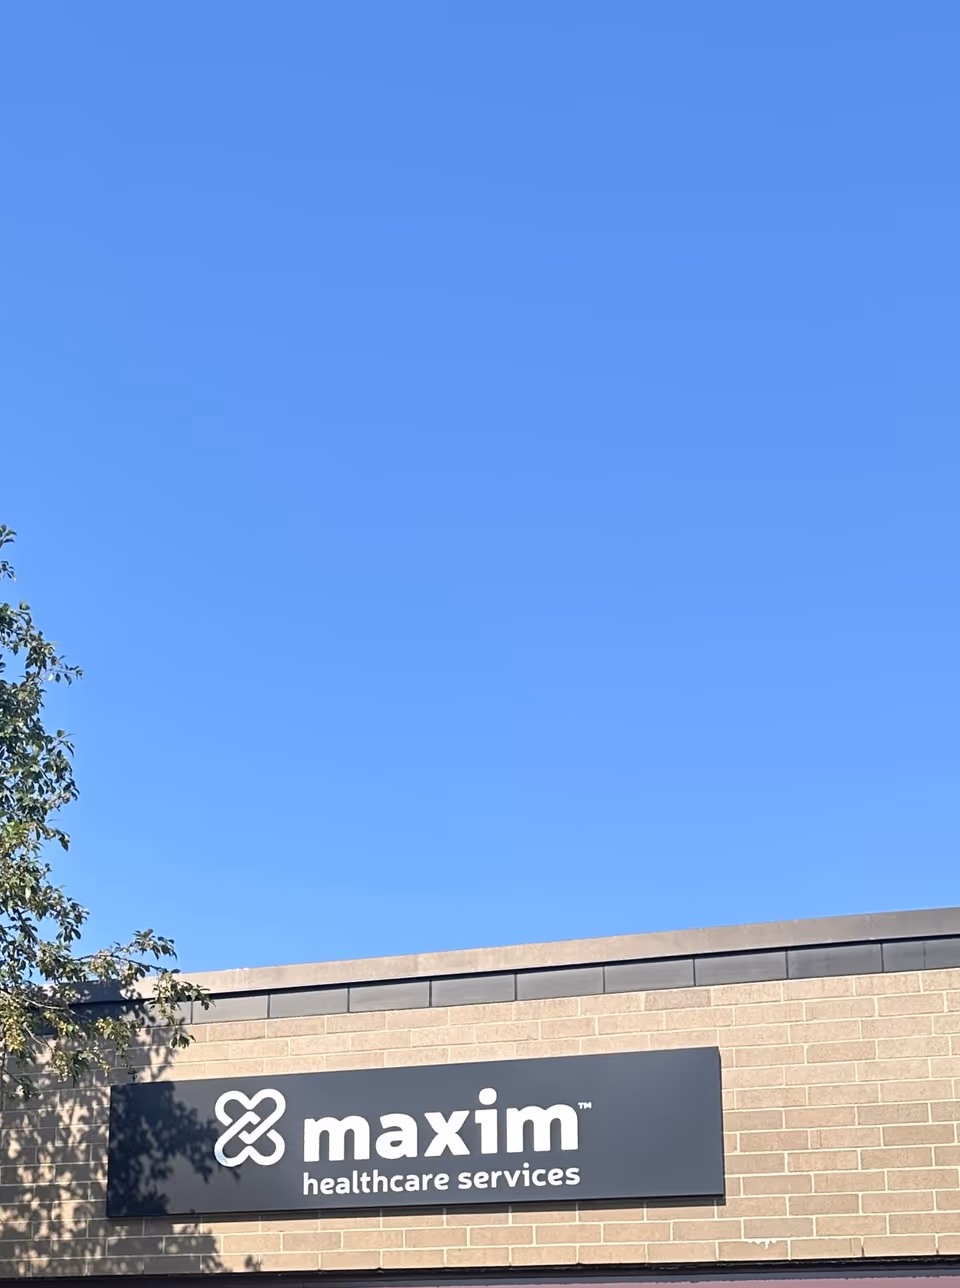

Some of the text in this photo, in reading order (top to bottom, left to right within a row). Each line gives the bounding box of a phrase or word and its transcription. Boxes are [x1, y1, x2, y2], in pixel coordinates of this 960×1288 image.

[303, 1088, 579, 1162] maxim
[302, 1162, 581, 1196] healthcare services
